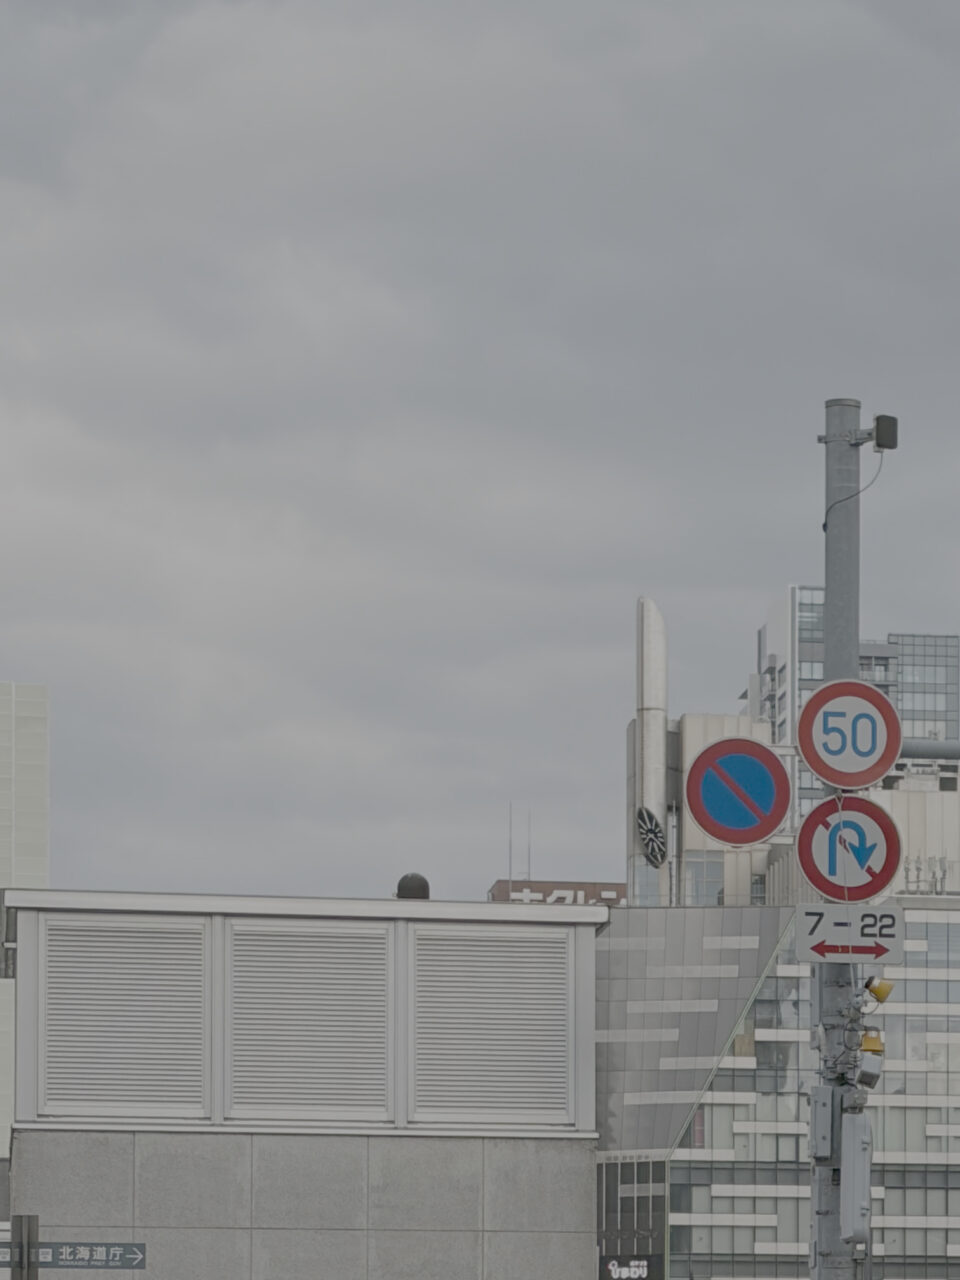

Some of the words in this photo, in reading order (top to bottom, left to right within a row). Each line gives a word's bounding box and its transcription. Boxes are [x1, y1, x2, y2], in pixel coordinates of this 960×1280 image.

[821, 711, 878, 758] 50
[58, 1245, 125, 1261] 北海道庁
